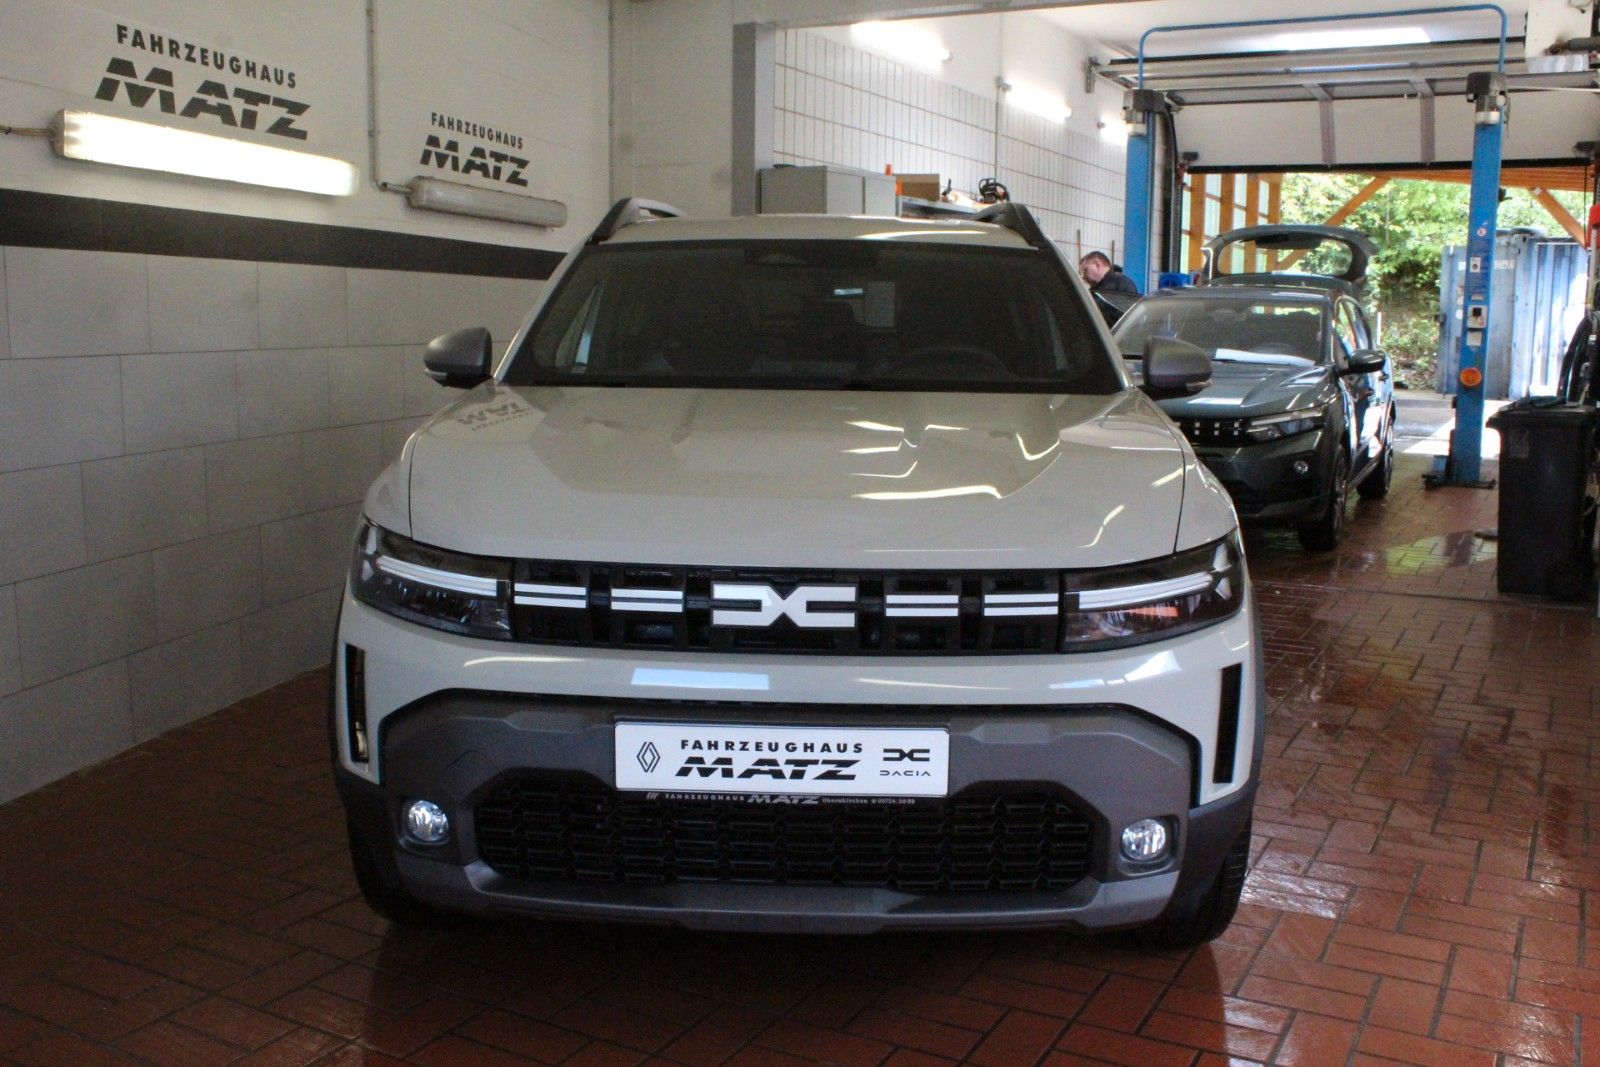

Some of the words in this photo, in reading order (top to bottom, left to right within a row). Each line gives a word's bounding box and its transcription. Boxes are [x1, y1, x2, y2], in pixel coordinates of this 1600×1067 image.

[116, 23, 297, 89] FAHRZEUGHAUS
[94, 56, 312, 141] MATZ
[431, 111, 523, 150] FAHRZEUGHAUS
[420, 134, 530, 187] MATZ
[680, 739, 863, 754] FAHRZEUGHAUS
[674, 756, 861, 781] MATZ
[747, 795, 820, 804] MATZ
